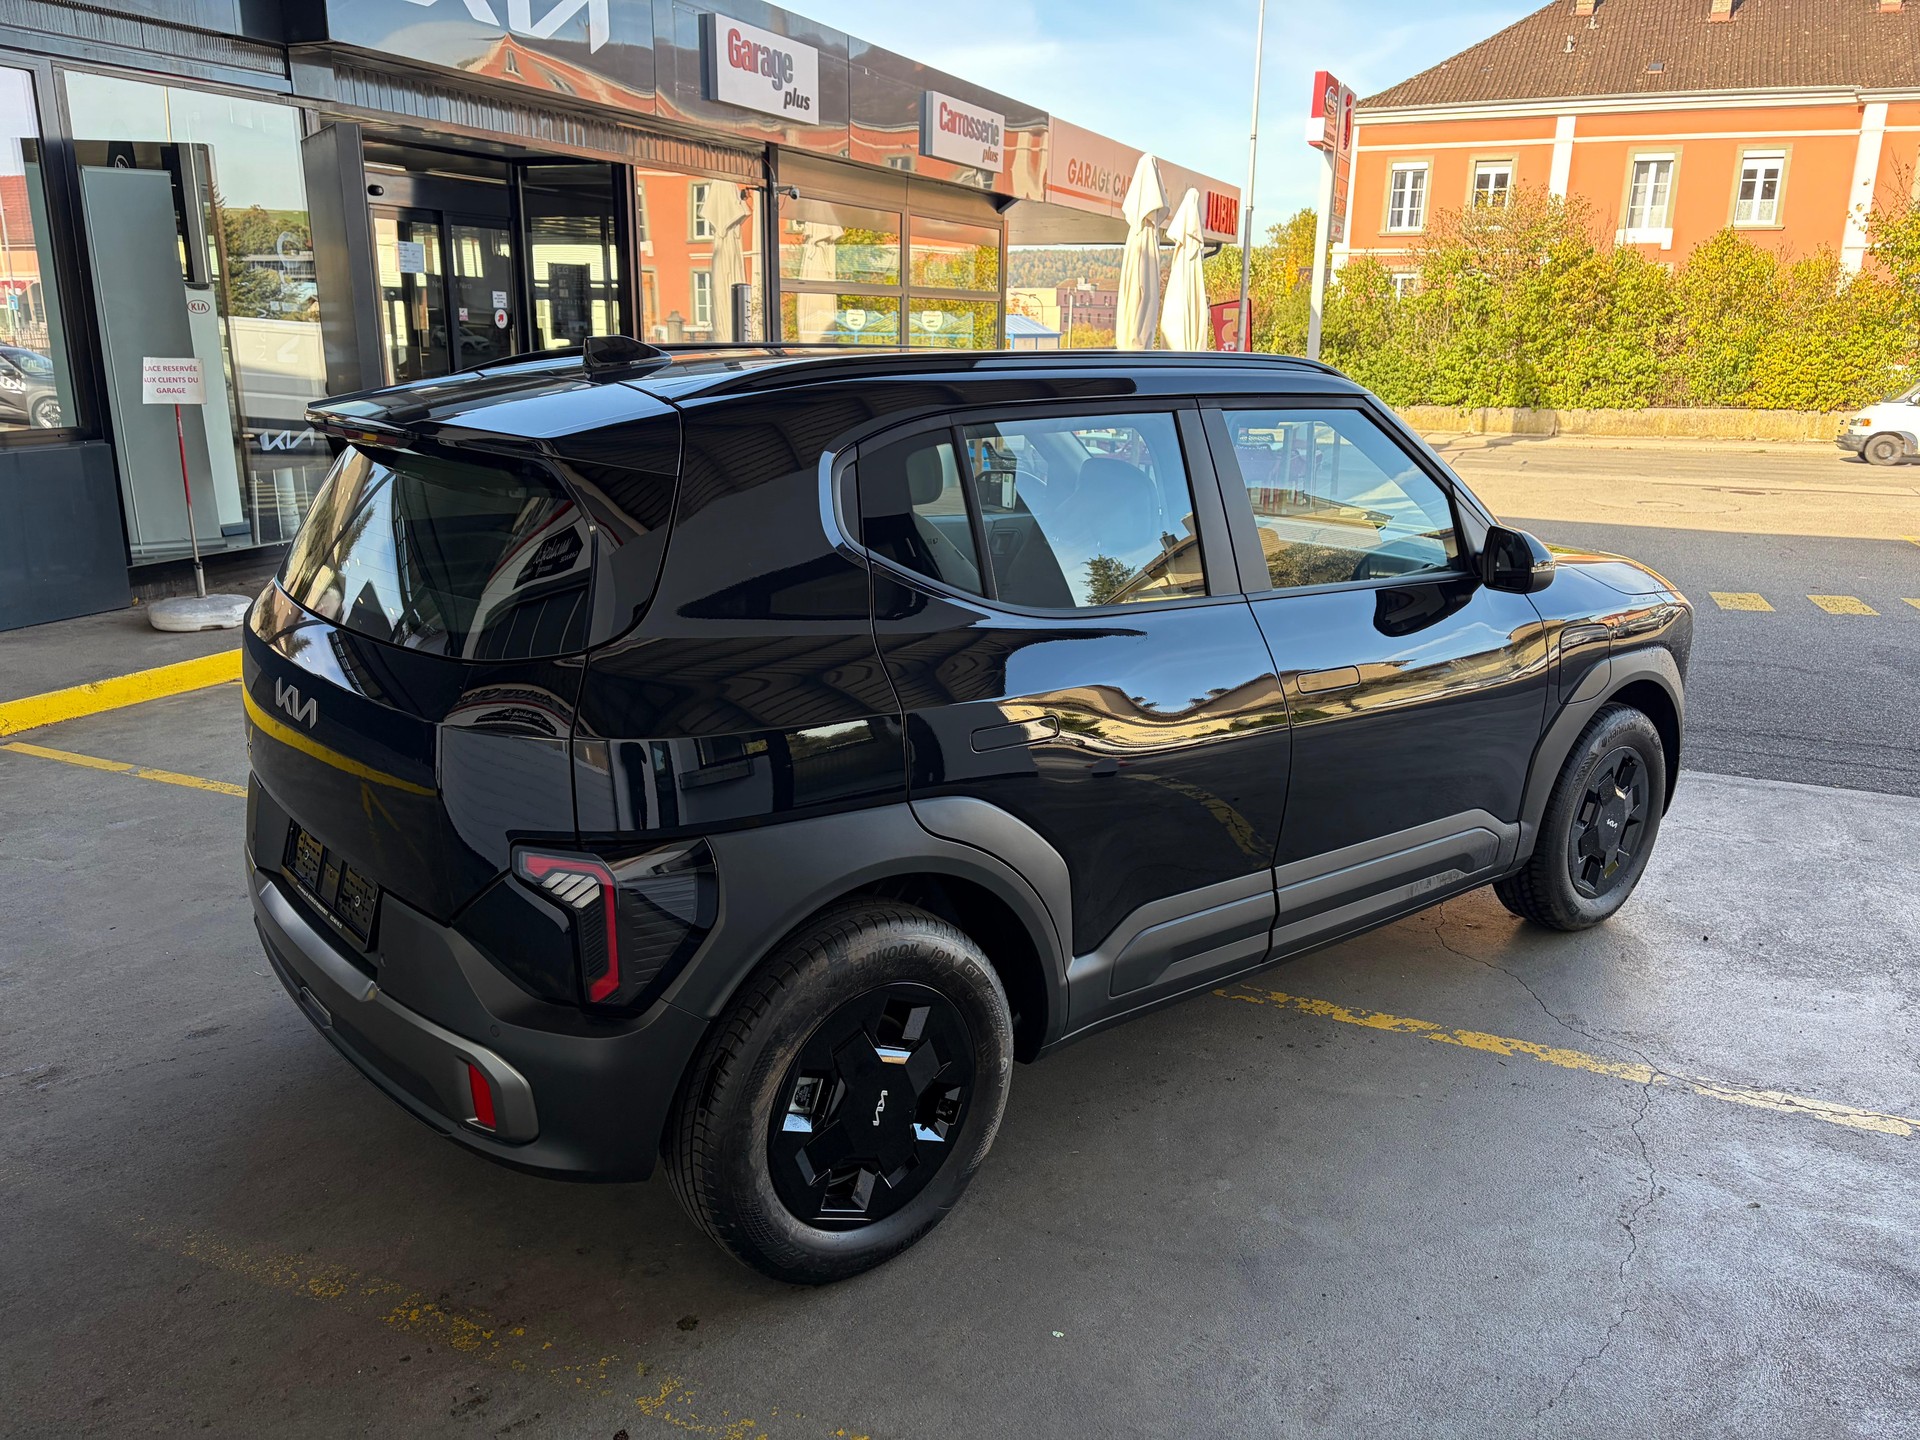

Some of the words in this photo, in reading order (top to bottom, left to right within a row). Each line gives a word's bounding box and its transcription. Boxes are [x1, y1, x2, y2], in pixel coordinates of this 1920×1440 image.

[727, 28, 794, 91] Garage
[783, 87, 811, 111] plus
[939, 101, 1000, 147] Carrosserie
[982, 146, 999, 163] plus
[1067, 158, 1112, 194] GARAGE
[1206, 191, 1239, 236] JUBIN
[191, 302, 207, 312] KIA
[275, 676, 317, 729] KIA
[964, 963, 981, 979] GT
